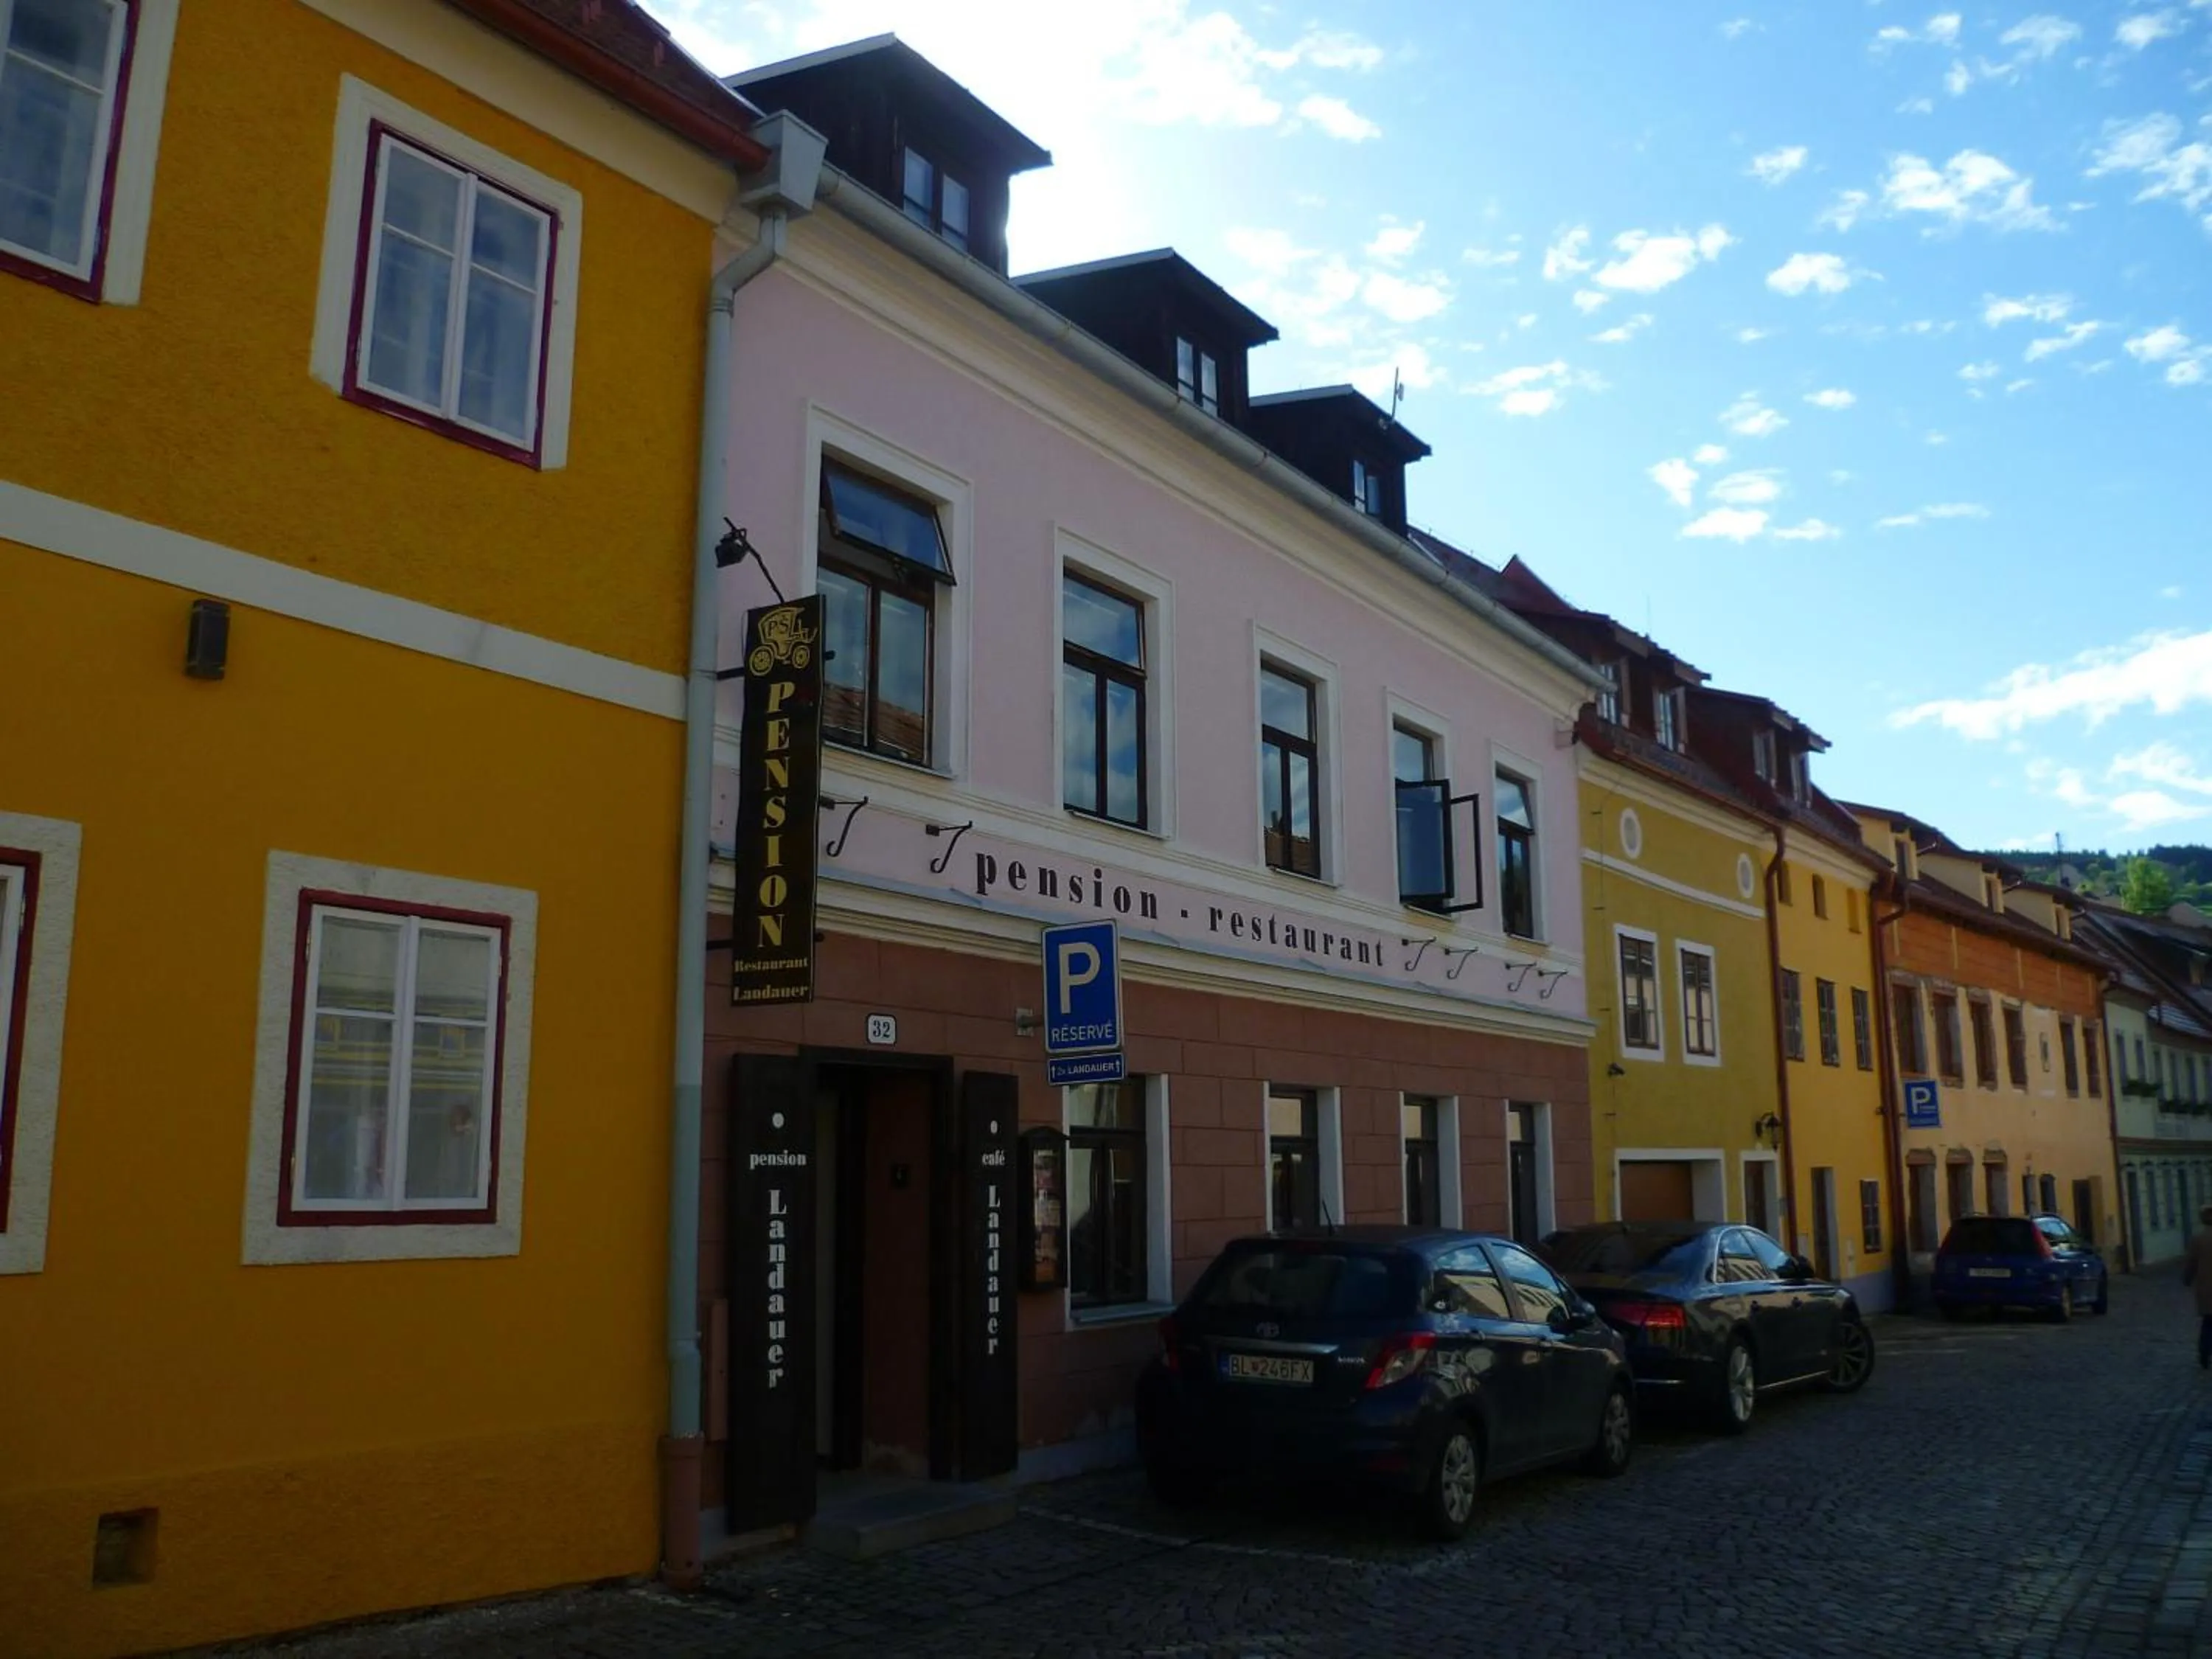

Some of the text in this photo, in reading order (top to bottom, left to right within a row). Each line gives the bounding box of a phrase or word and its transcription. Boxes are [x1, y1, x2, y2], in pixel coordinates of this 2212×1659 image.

[757, 681, 796, 948] PENSION
[975, 852, 1159, 920] pension
[1208, 904, 1385, 967] restaurant
[734, 956, 809, 972] Restaurant
[1058, 942, 1101, 1015] P
[733, 984, 809, 1001] Landauer
[872, 1020, 891, 1038] 32
[1910, 1086, 1931, 1115] P
[749, 1150, 807, 1169] pension
[981, 1150, 1006, 1166] café
[987, 1185, 1001, 1355] Landauer
[768, 1189, 787, 1388] Landauer
